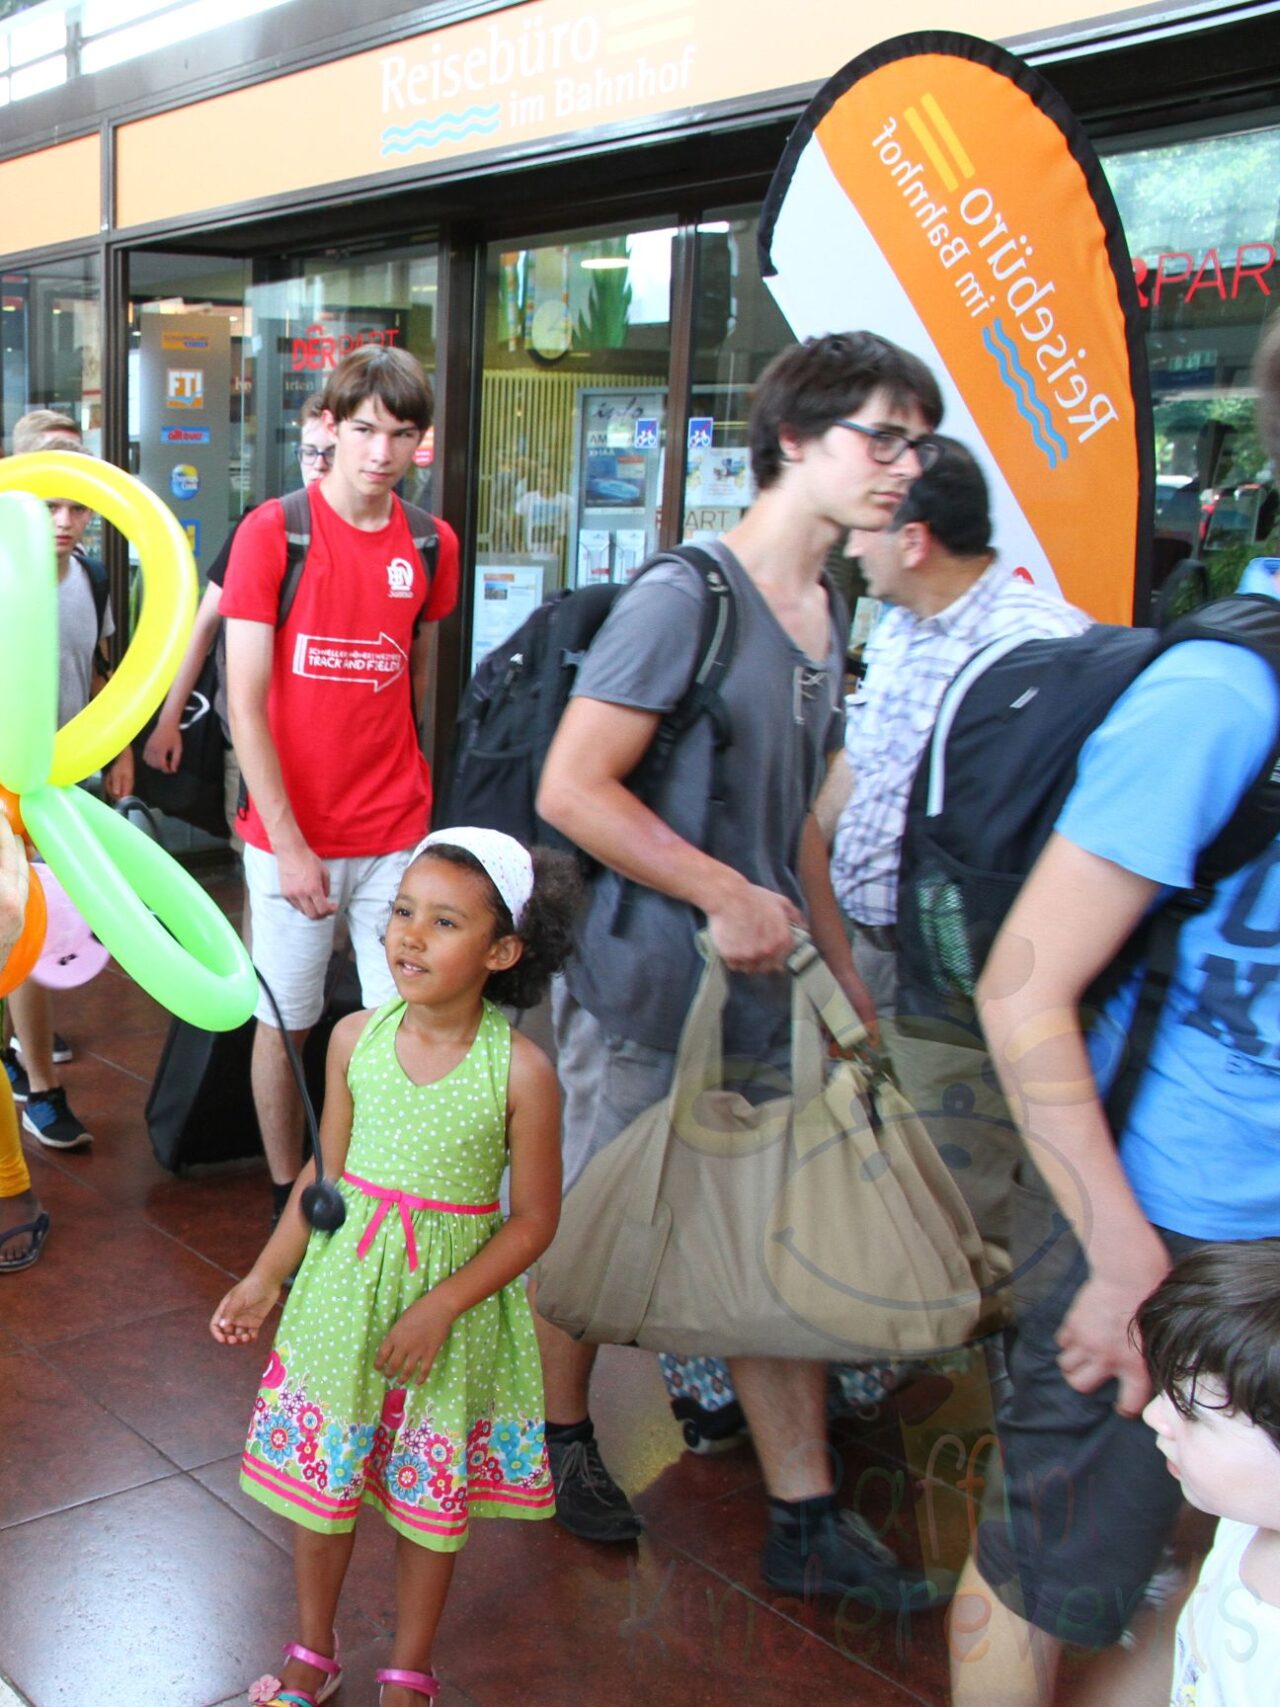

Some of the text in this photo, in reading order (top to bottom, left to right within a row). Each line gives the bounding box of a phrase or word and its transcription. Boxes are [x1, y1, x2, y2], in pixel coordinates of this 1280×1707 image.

[379, 15, 600, 113] Reisebüro
[509, 44, 697, 128] im Bahnhof
[168, 370, 203, 398] FTI
[308, 656, 341, 668] TRACK
[344, 657, 365, 670] AND
